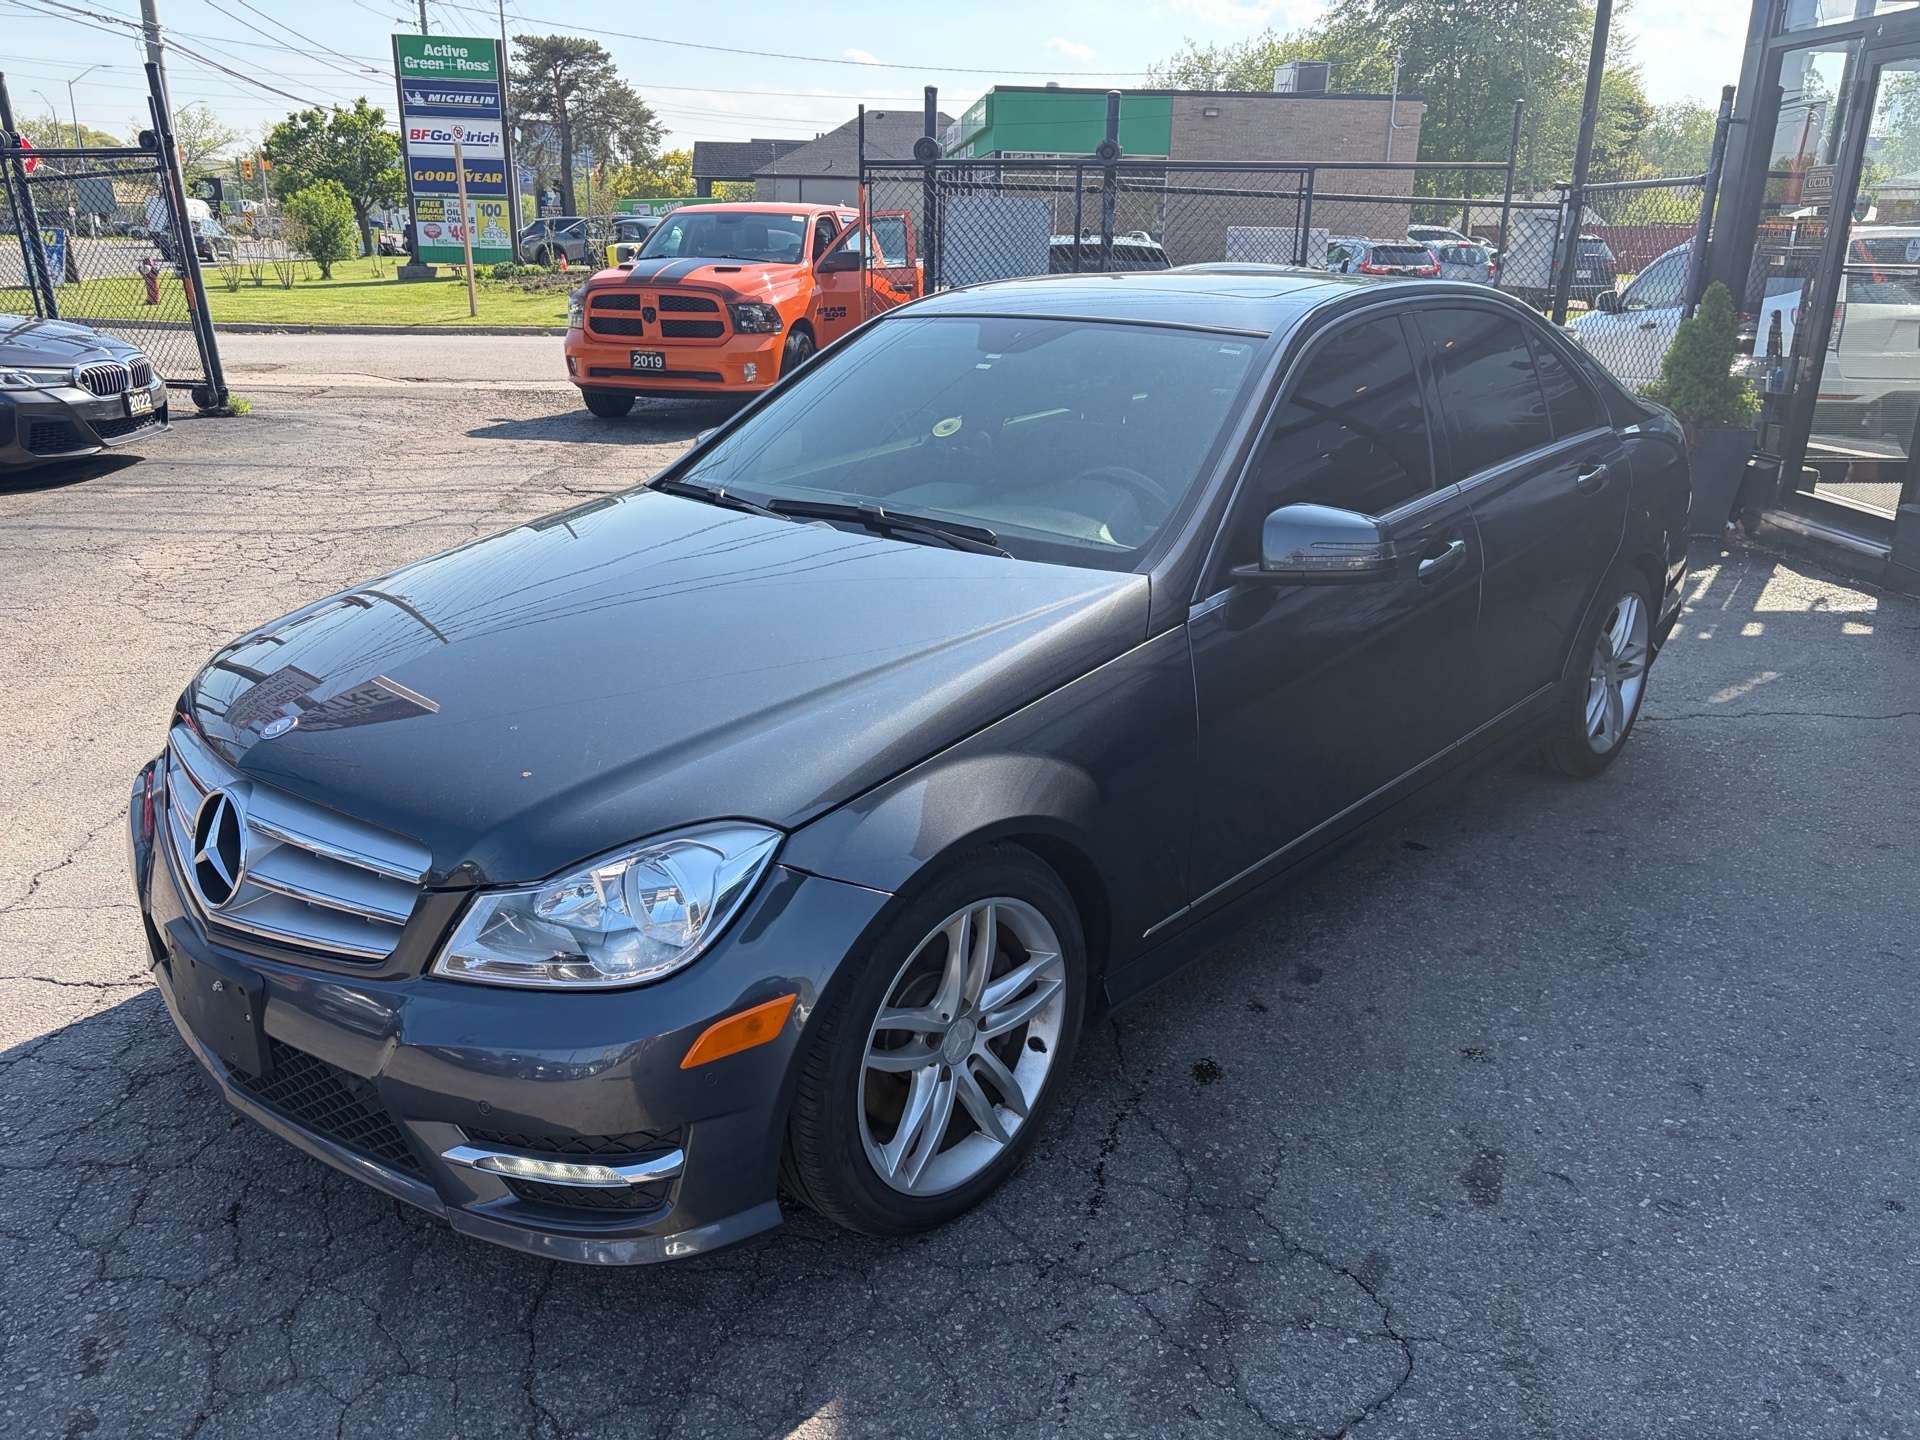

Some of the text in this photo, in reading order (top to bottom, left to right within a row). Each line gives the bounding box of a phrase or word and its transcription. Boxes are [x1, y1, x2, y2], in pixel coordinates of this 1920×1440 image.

[423, 43, 469, 58] Active
[427, 93, 495, 105] MICHELIN
[409, 128, 499, 143] BFGodrich
[633, 354, 663, 368] 2019
[129, 392, 153, 412] 2022
